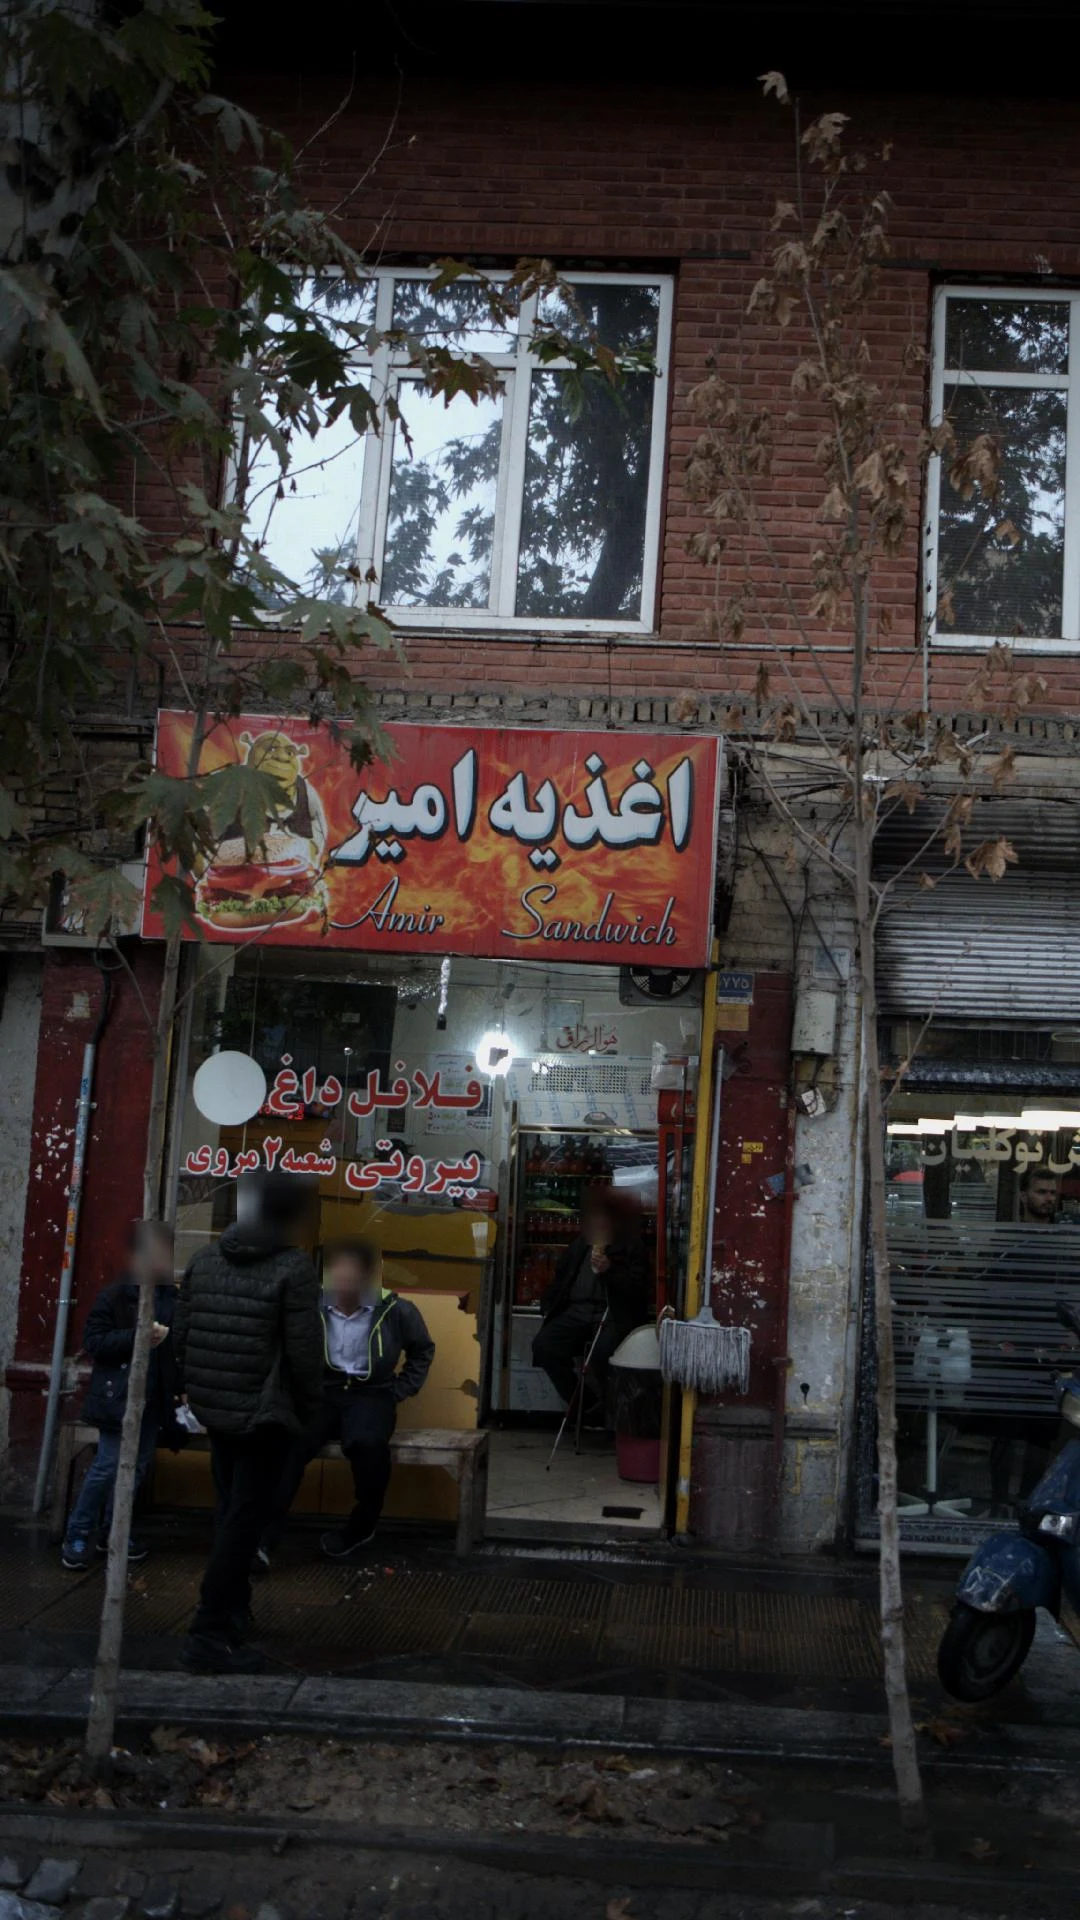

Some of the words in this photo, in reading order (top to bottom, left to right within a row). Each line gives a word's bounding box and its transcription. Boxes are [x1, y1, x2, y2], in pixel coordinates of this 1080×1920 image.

[329, 747, 479, 867] امیر
[489, 752, 695, 873] اغذیه
[329, 876, 446, 935] Amir
[502, 883, 678, 946] Sandwich
[267, 1052, 343, 1113] داغ
[347, 1058, 484, 1118] فلافل
[345, 1138, 481, 1200] بیروتی
